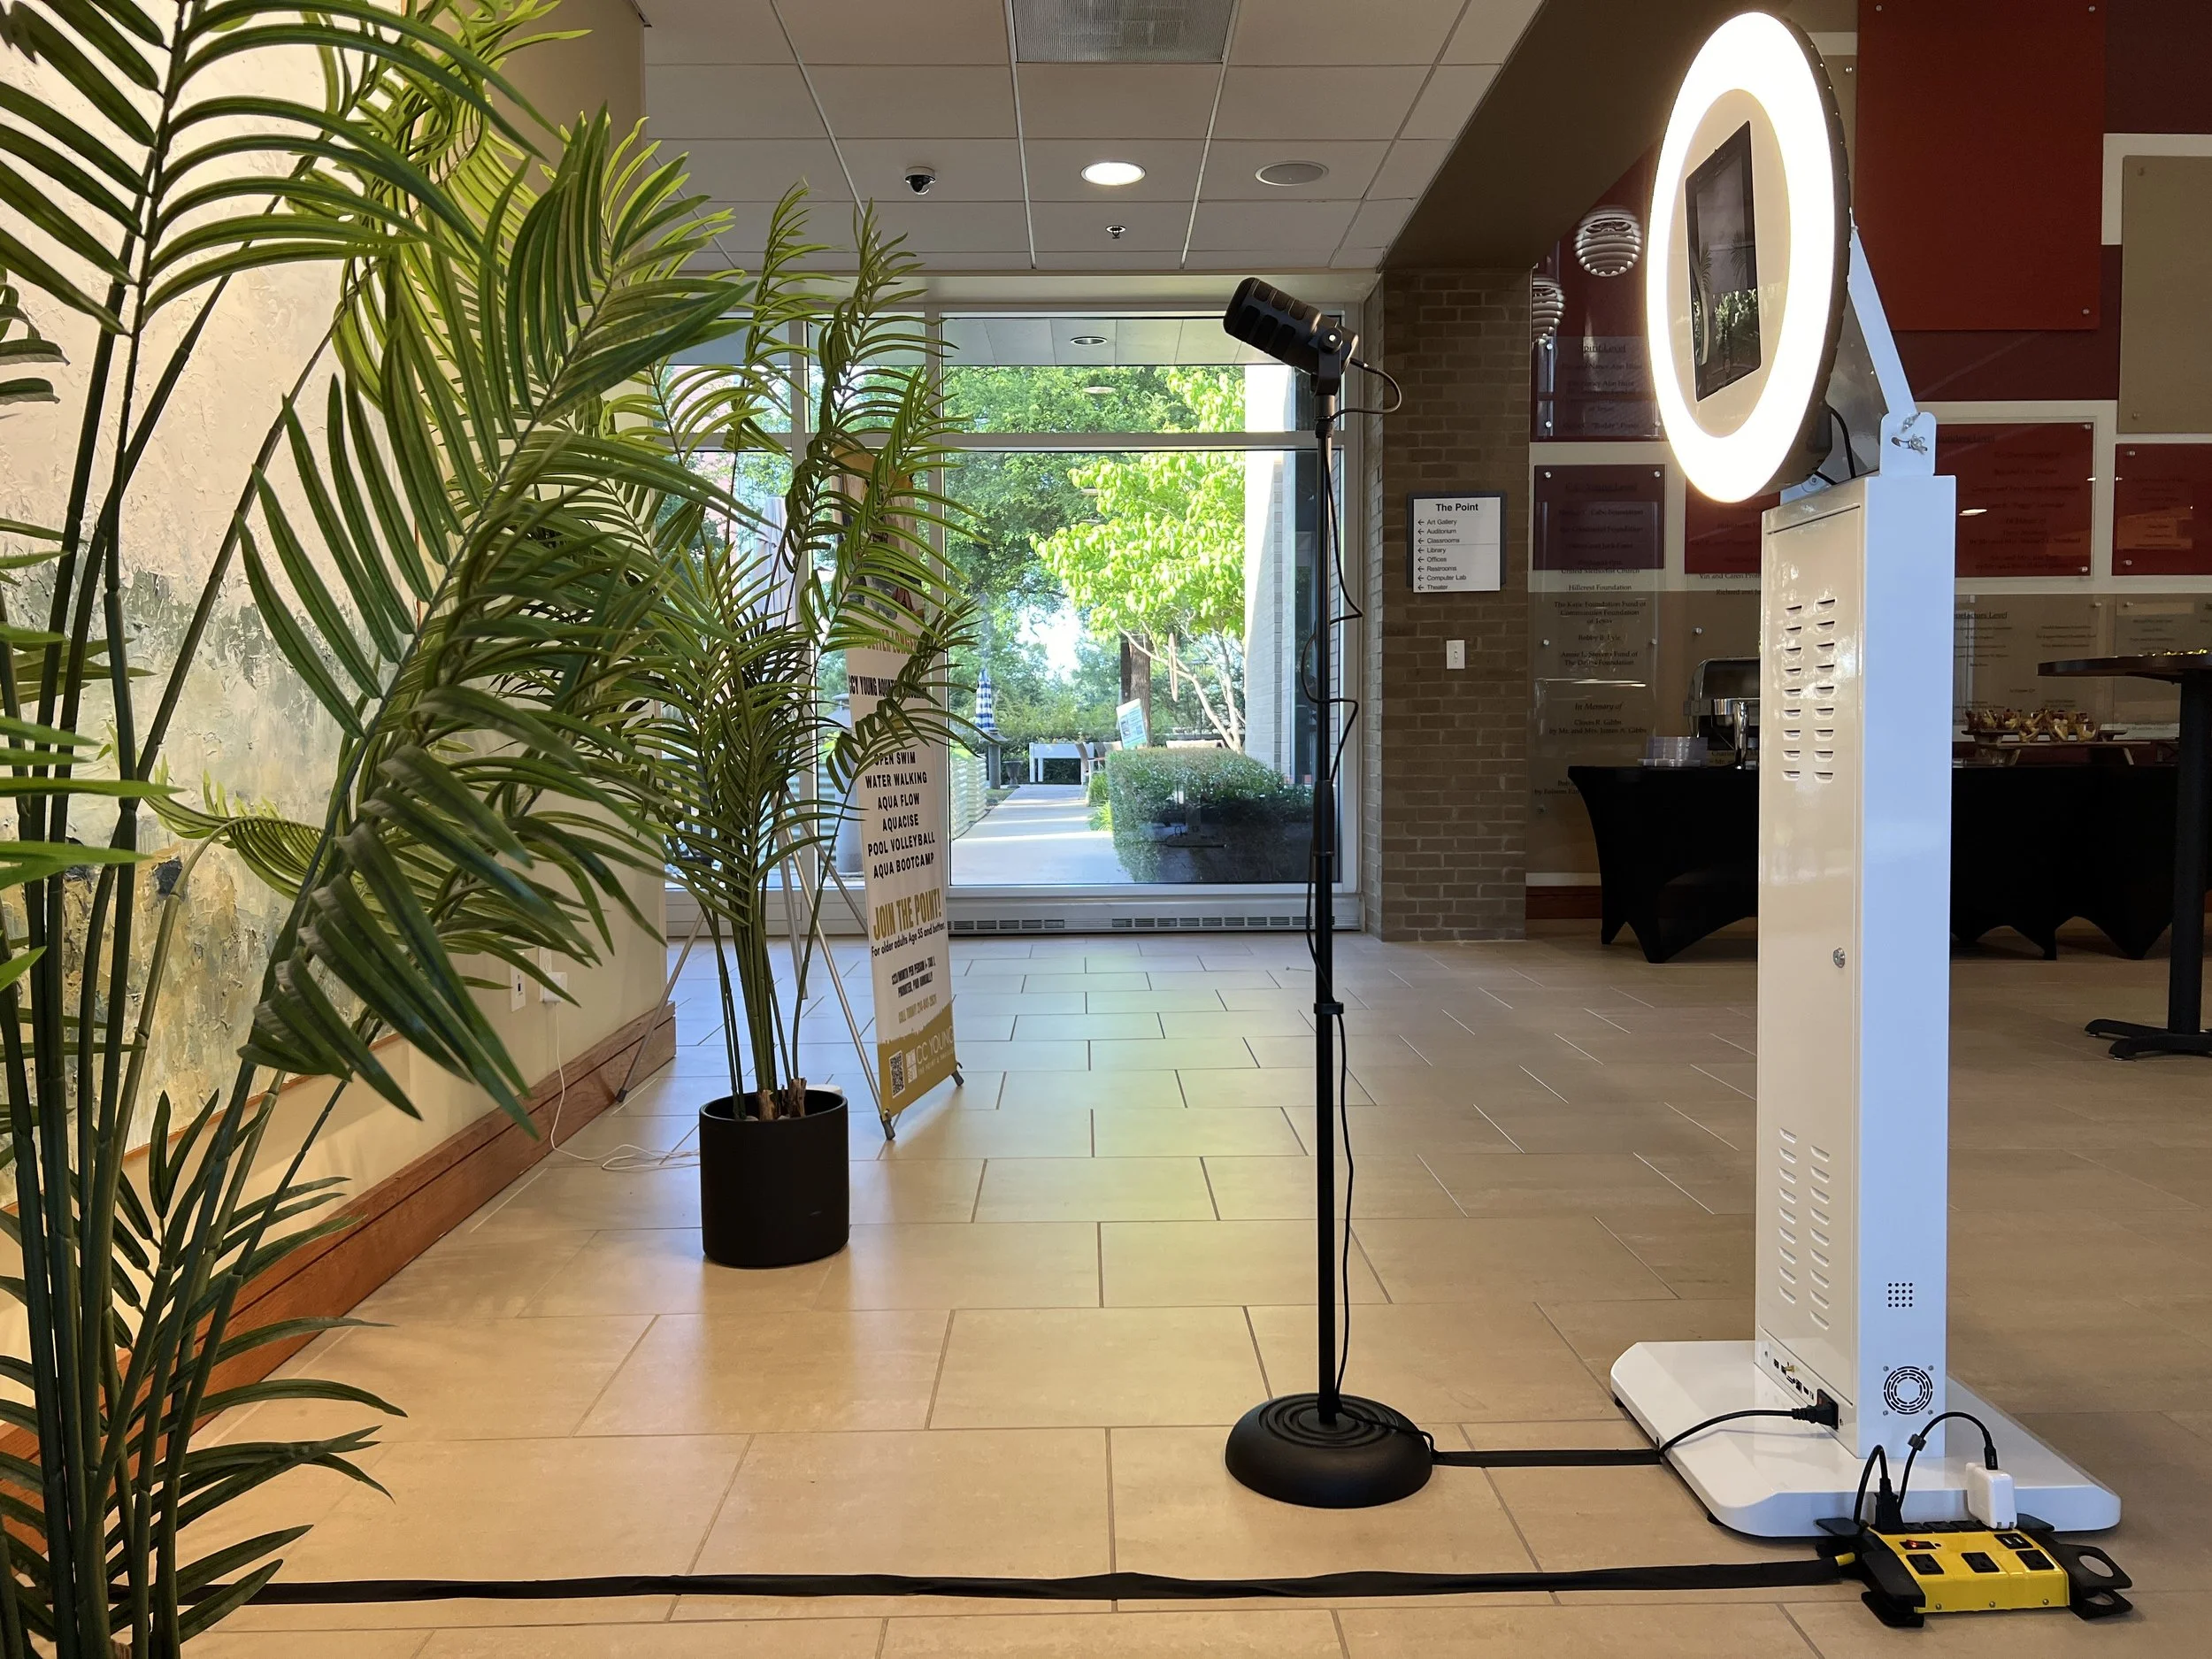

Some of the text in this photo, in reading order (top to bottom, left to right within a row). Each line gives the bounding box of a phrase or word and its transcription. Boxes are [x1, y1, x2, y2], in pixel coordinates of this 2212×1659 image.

[896, 751, 916, 764] SWIM
[865, 772, 927, 788] WATER WALKING
[878, 793, 920, 811] AQUA FLOW
[883, 814, 918, 832] AQUACISE
[868, 832, 935, 856] POOL VOLLEYBALL
[873, 852, 934, 879] AQUA BOOTCAMP
[873, 887, 941, 941] JOIN THE POINT!
[872, 946, 880, 957] For
[881, 940, 894, 955] older
[895, 934, 908, 949] adults
[909, 932, 918, 945] Age
[924, 923, 933, 937] and
[917, 1025, 953, 1064] CC YOUNG
